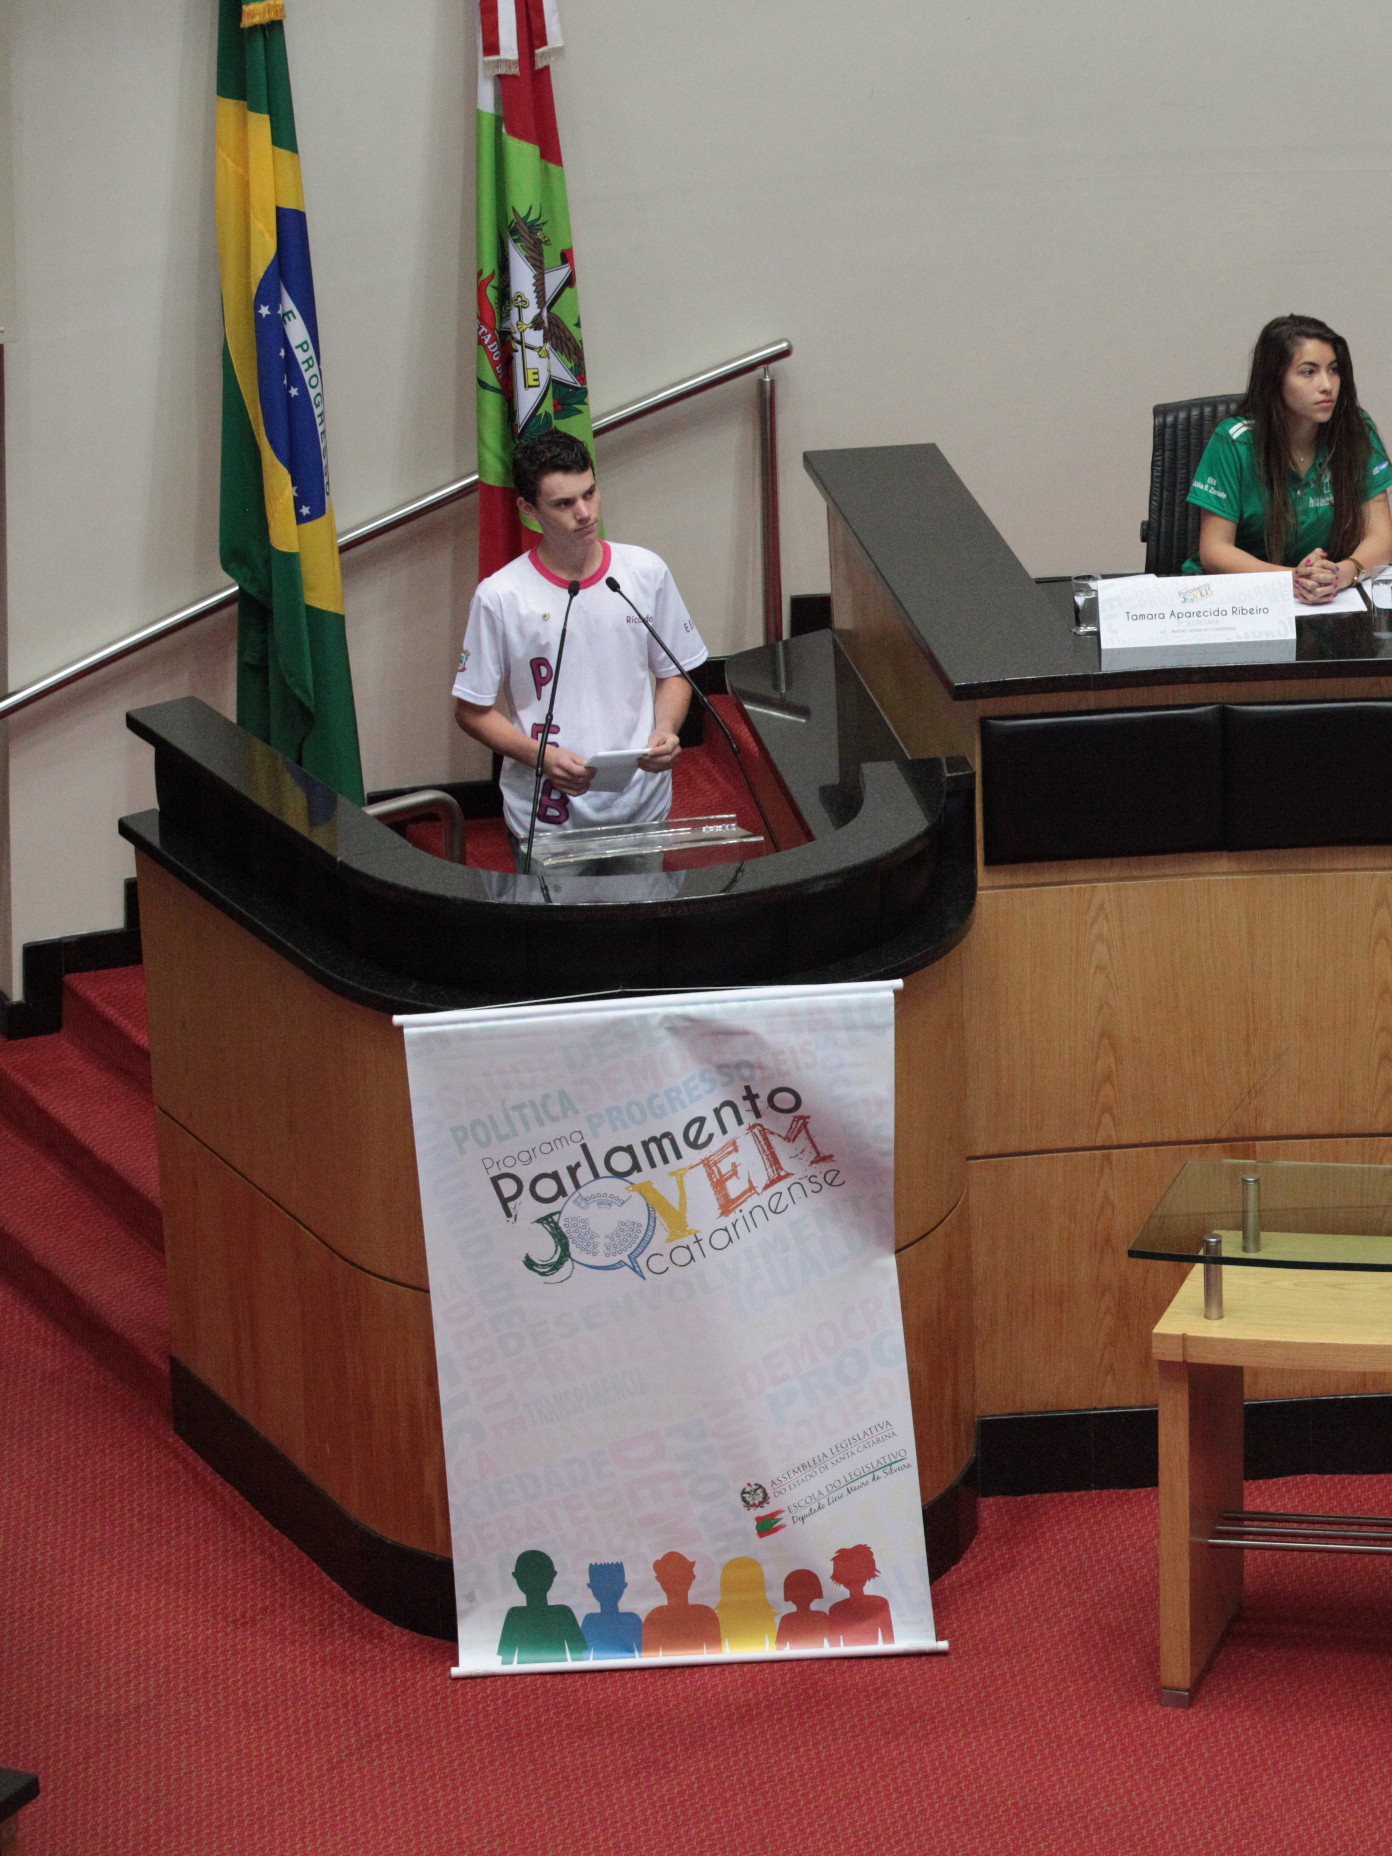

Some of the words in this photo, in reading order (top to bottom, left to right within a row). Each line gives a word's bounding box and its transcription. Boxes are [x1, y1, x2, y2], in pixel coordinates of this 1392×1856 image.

[1125, 611, 1166, 622] Tamara
[1169, 607, 1228, 620] Aparecida
[1231, 605, 1270, 616] Ribeiro
[481, 1127, 586, 1177] Programa
[487, 1083, 804, 1221] Parlamento
[645, 1166, 848, 1277] catarinense
[770, 1452, 828, 1489] ASSEMBLEIA
[829, 1419, 894, 1456] LEGISLATIVA
[773, 1487, 787, 1498] DO
[788, 1470, 818, 1491] ESTADO
[819, 1463, 830, 1475] DE
[831, 1450, 857, 1467] SANTA
[856, 1430, 898, 1453] CATARINA
[786, 1489, 824, 1514] ESCOLA
[825, 1478, 842, 1493] DO
[842, 1448, 908, 1484] LEGISLATIVO
